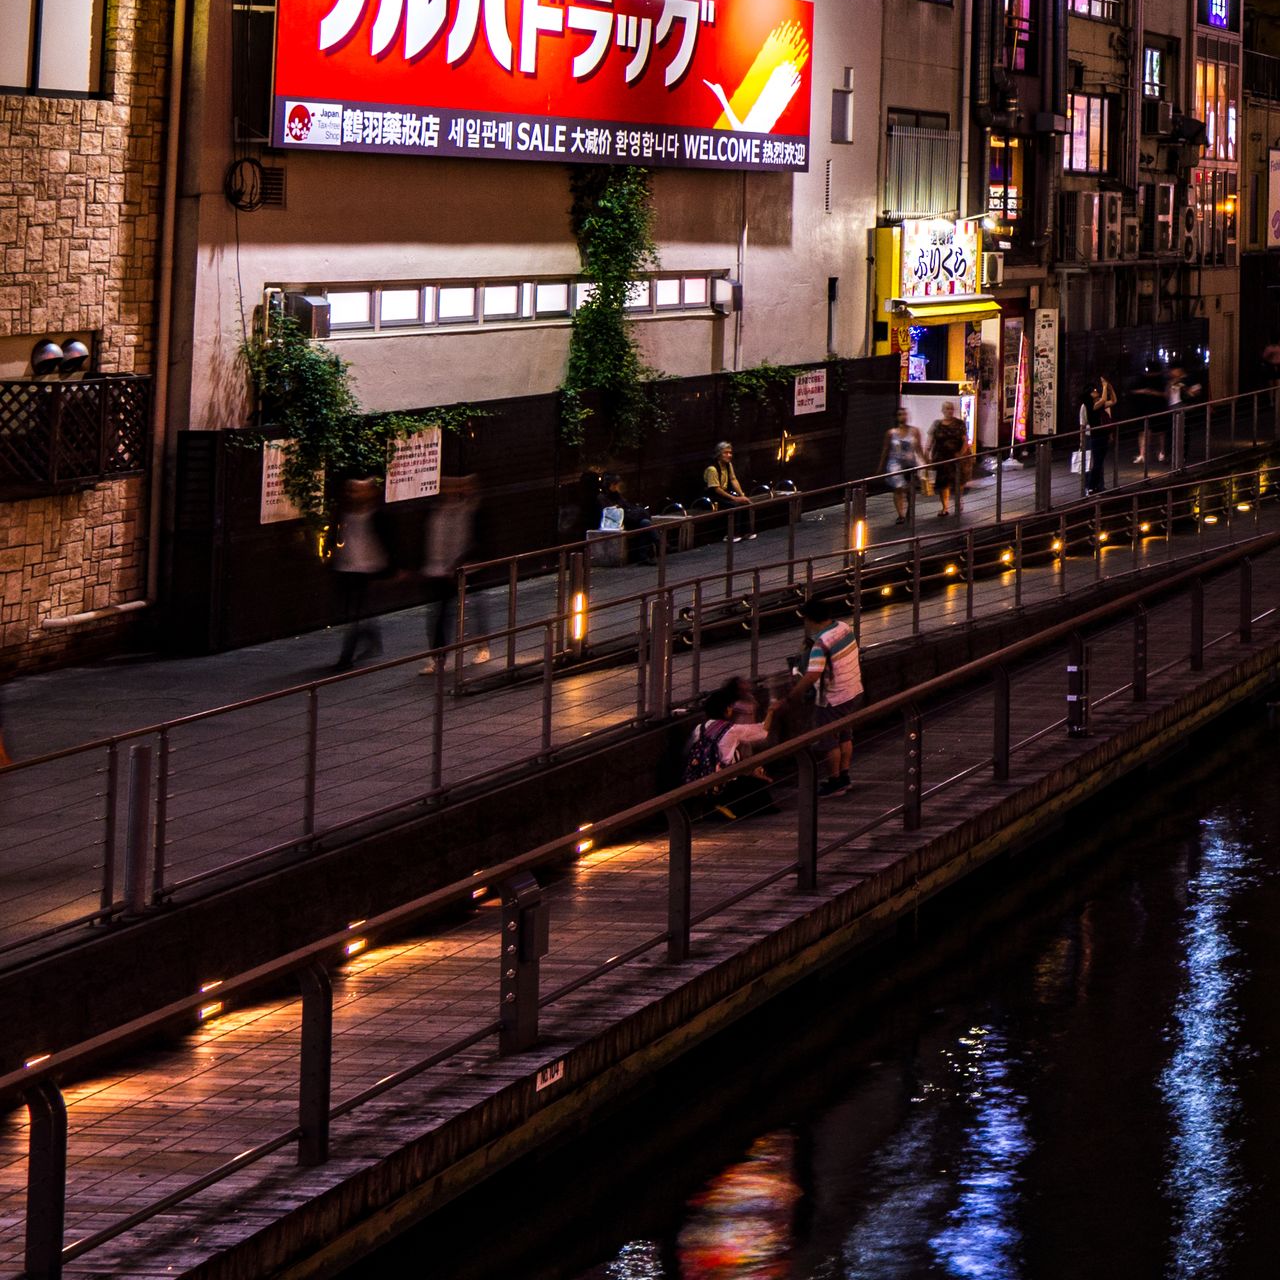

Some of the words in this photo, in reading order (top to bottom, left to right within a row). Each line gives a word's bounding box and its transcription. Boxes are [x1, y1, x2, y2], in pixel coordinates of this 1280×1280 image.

[320, 108, 339, 118] Japan
[448, 117, 513, 150] 세일판매
[516, 122, 567, 153] SALE
[615, 129, 680, 159] 환영합니다
[684, 133, 760, 163] WELCOME
